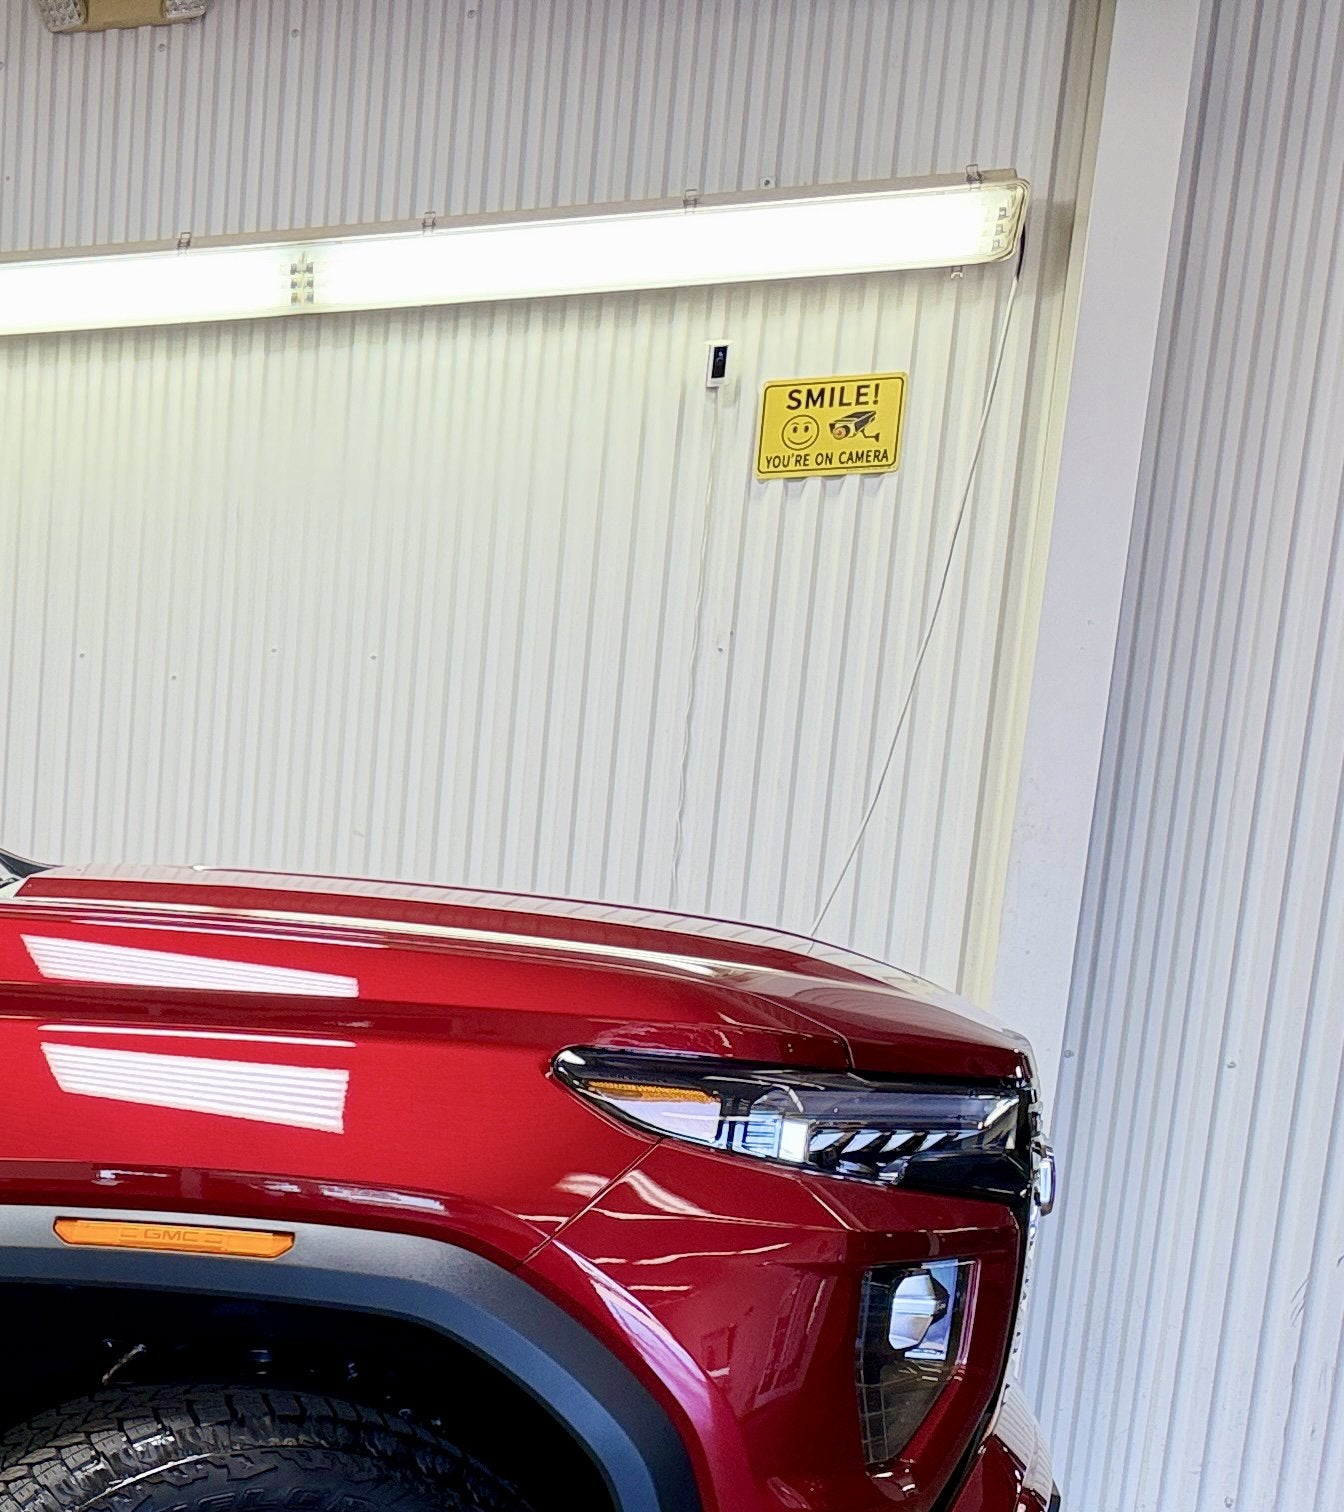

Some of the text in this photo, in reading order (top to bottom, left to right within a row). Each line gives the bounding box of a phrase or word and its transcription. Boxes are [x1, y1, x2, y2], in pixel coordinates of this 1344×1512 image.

[786, 383, 880, 411] SMILE!
[765, 449, 889, 469] YOU'RE ON CAMERA
[143, 1228, 200, 1243] GMC
